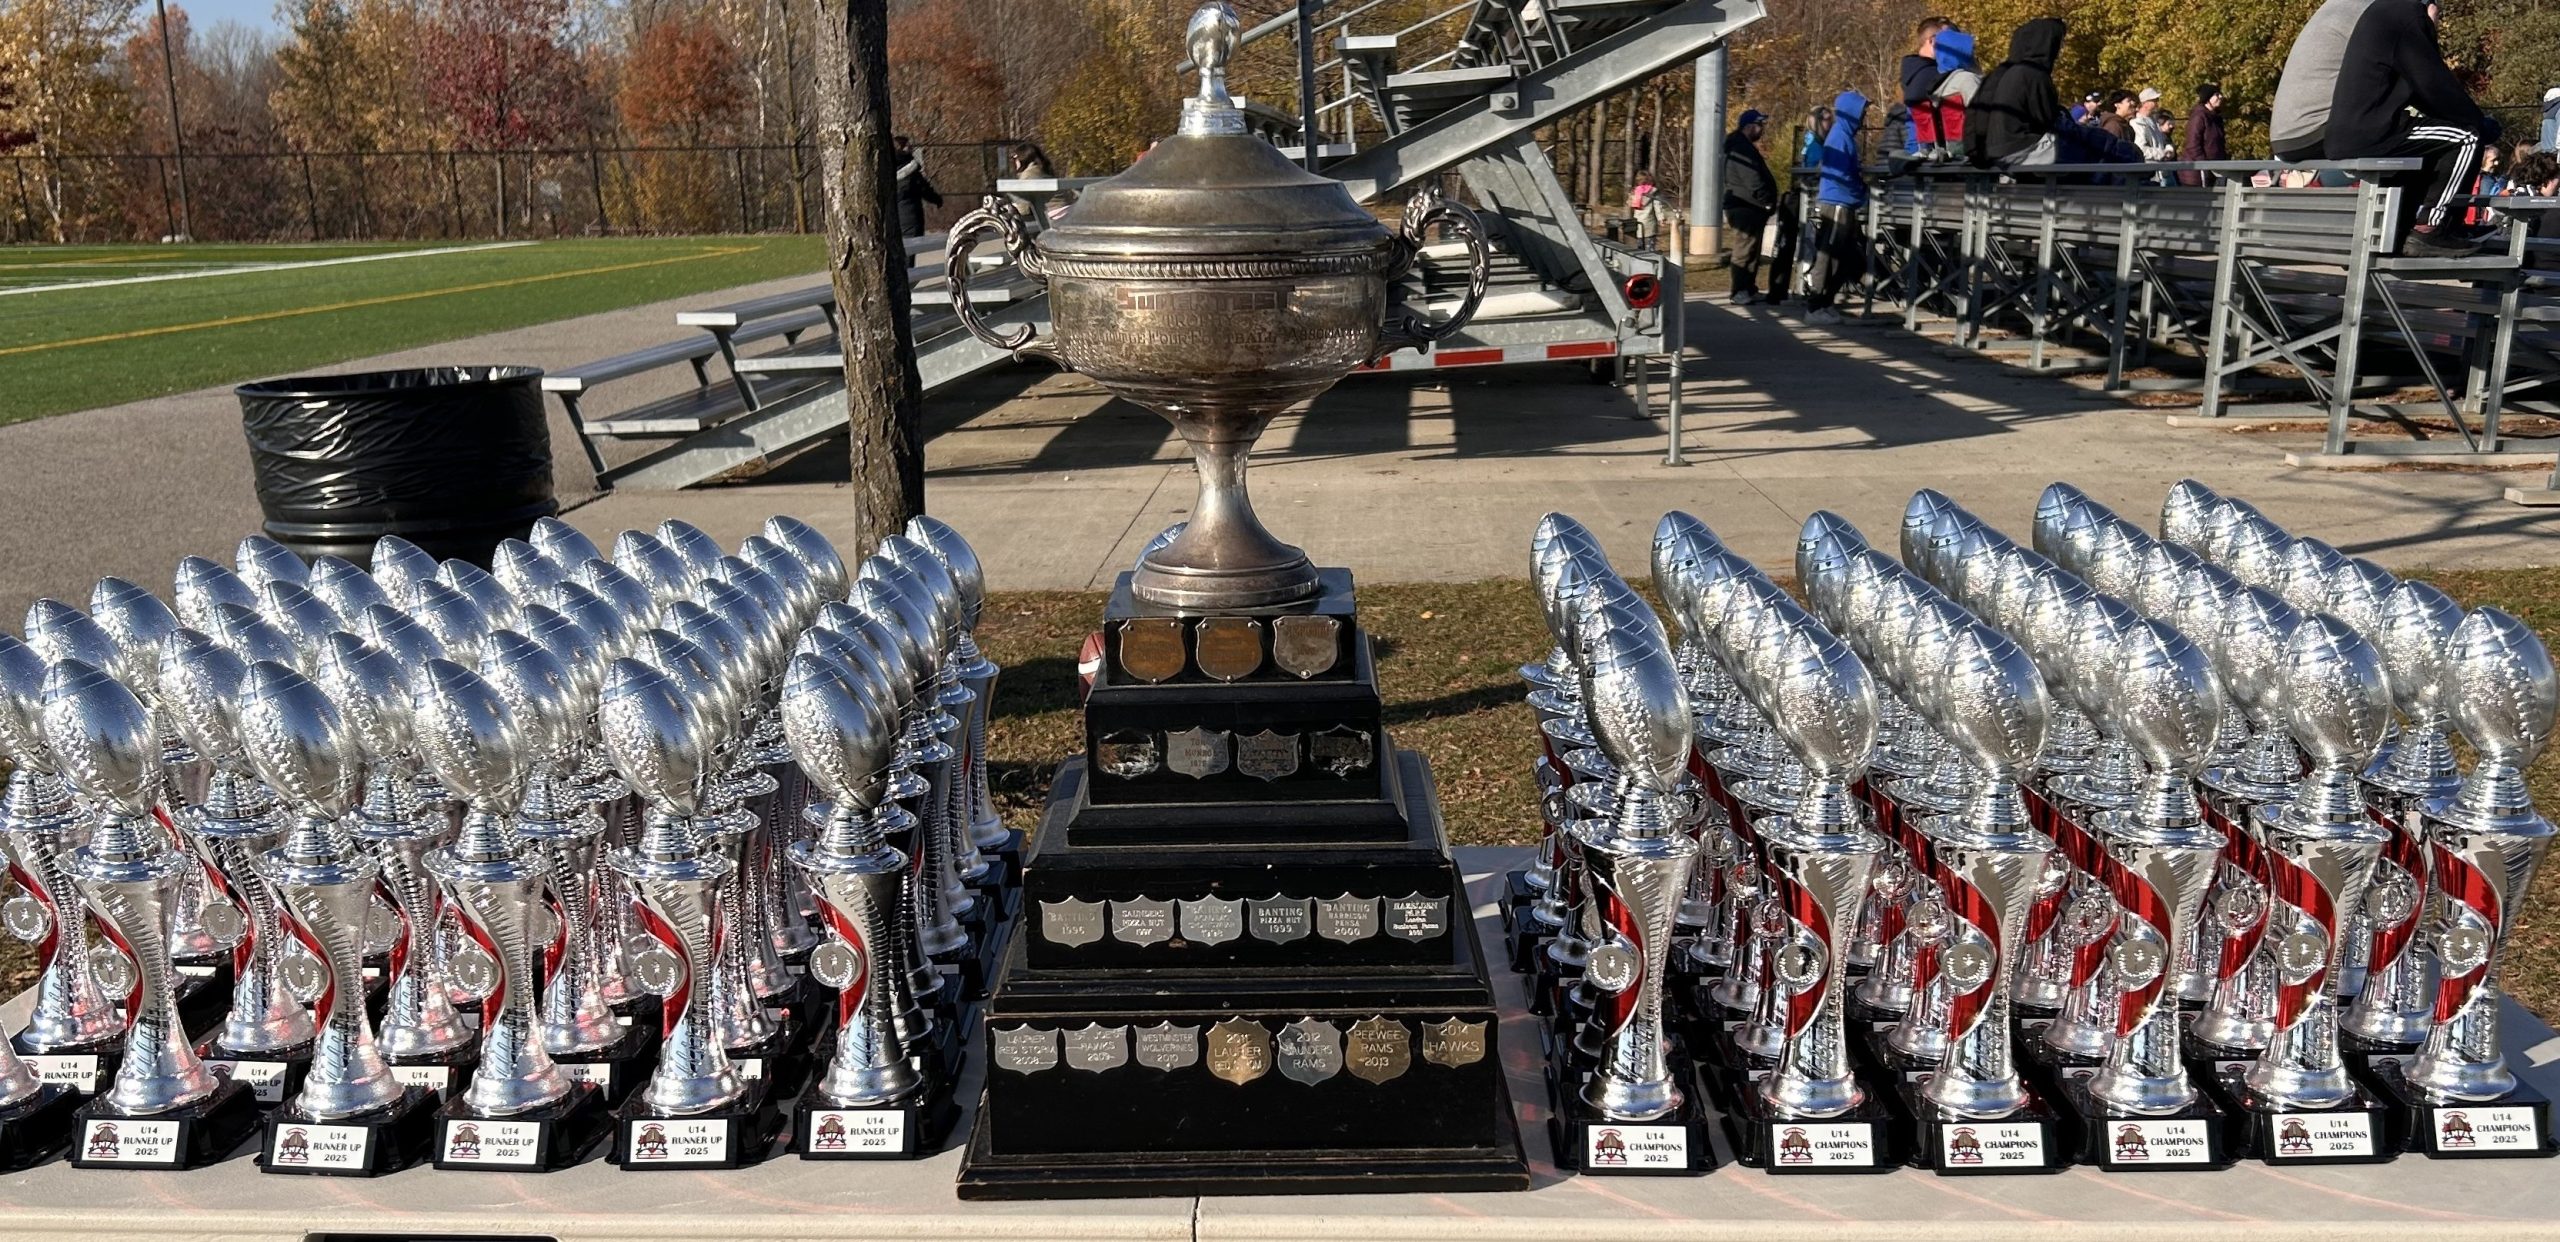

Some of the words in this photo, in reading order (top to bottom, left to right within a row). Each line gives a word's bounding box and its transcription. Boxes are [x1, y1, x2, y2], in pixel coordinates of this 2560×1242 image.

[1258, 907, 1303, 917] BANTING
[1326, 903, 1370, 912] BANTING
[1270, 924, 1292, 933] 1999
[1335, 927, 1361, 936] 2000
[1353, 1029, 1401, 1040] PEEWEE
[1440, 1024, 1469, 1036] 2014
[1296, 1032, 1321, 1043] 2012
[1361, 1043, 1394, 1053] RAMS
[1429, 1040, 1480, 1052] HAWKS
[1214, 1046, 1262, 1058] LAURIER
[1157, 1054, 1179, 1063] 2010
[1364, 1056, 1389, 1067] 2013
[60, 1061, 78, 1070] U14
[1293, 1058, 1326, 1069] RAMS
[44, 1071, 79, 1080] RUNNER
[80, 1071, 93, 1079] UP
[251, 1068, 268, 1076] U14
[411, 1071, 429, 1079] U14
[573, 1068, 591, 1076] U14
[270, 1079, 282, 1087] UP
[866, 1117, 884, 1125] U14
[2492, 1113, 2512, 1121] U14
[2329, 1120, 2349, 1128] U14
[2476, 1124, 2531, 1133] CHAMPIONS
[140, 1126, 158, 1134] U14
[501, 1127, 519, 1135] U14
[688, 1125, 706, 1134] U14
[850, 1127, 885, 1136] RUNNER
[887, 1127, 900, 1135] UP
[1831, 1130, 1850, 1138] U14
[2000, 1129, 2020, 1138] U14
[2166, 1126, 2186, 1135] U14
[329, 1132, 347, 1140] U14
[1646, 1132, 1665, 1140] U14
[2313, 1130, 2368, 1140] CHAMPIONS
[2493, 1135, 2518, 1144] 2025
[123, 1136, 159, 1145] RUNNER
[160, 1137, 173, 1146] UP
[484, 1137, 520, 1146] RUNNER
[521, 1138, 535, 1147] UP
[671, 1136, 708, 1145] RUNNER
[710, 1136, 723, 1144] UP
[862, 1138, 886, 1146] 2025
[1984, 1140, 2039, 1149] CHAMPIONS
[2150, 1137, 2205, 1146] CHAMPIONS
[312, 1142, 348, 1151] RUNNER
[349, 1143, 362, 1152] UP
[1629, 1143, 1683, 1152] CHAMPIONS
[1814, 1141, 1869, 1150] CHAMPIONS
[2329, 1142, 2355, 1151] 2025
[134, 1147, 159, 1156] 2025
[496, 1148, 520, 1157] 2025
[684, 1146, 709, 1156] 2025
[1829, 1151, 1855, 1160] 2025
[1999, 1151, 2025, 1160] 2025
[2165, 1148, 2191, 1157] 2025
[323, 1154, 347, 1162] 2025
[1644, 1154, 1669, 1163] 2025
